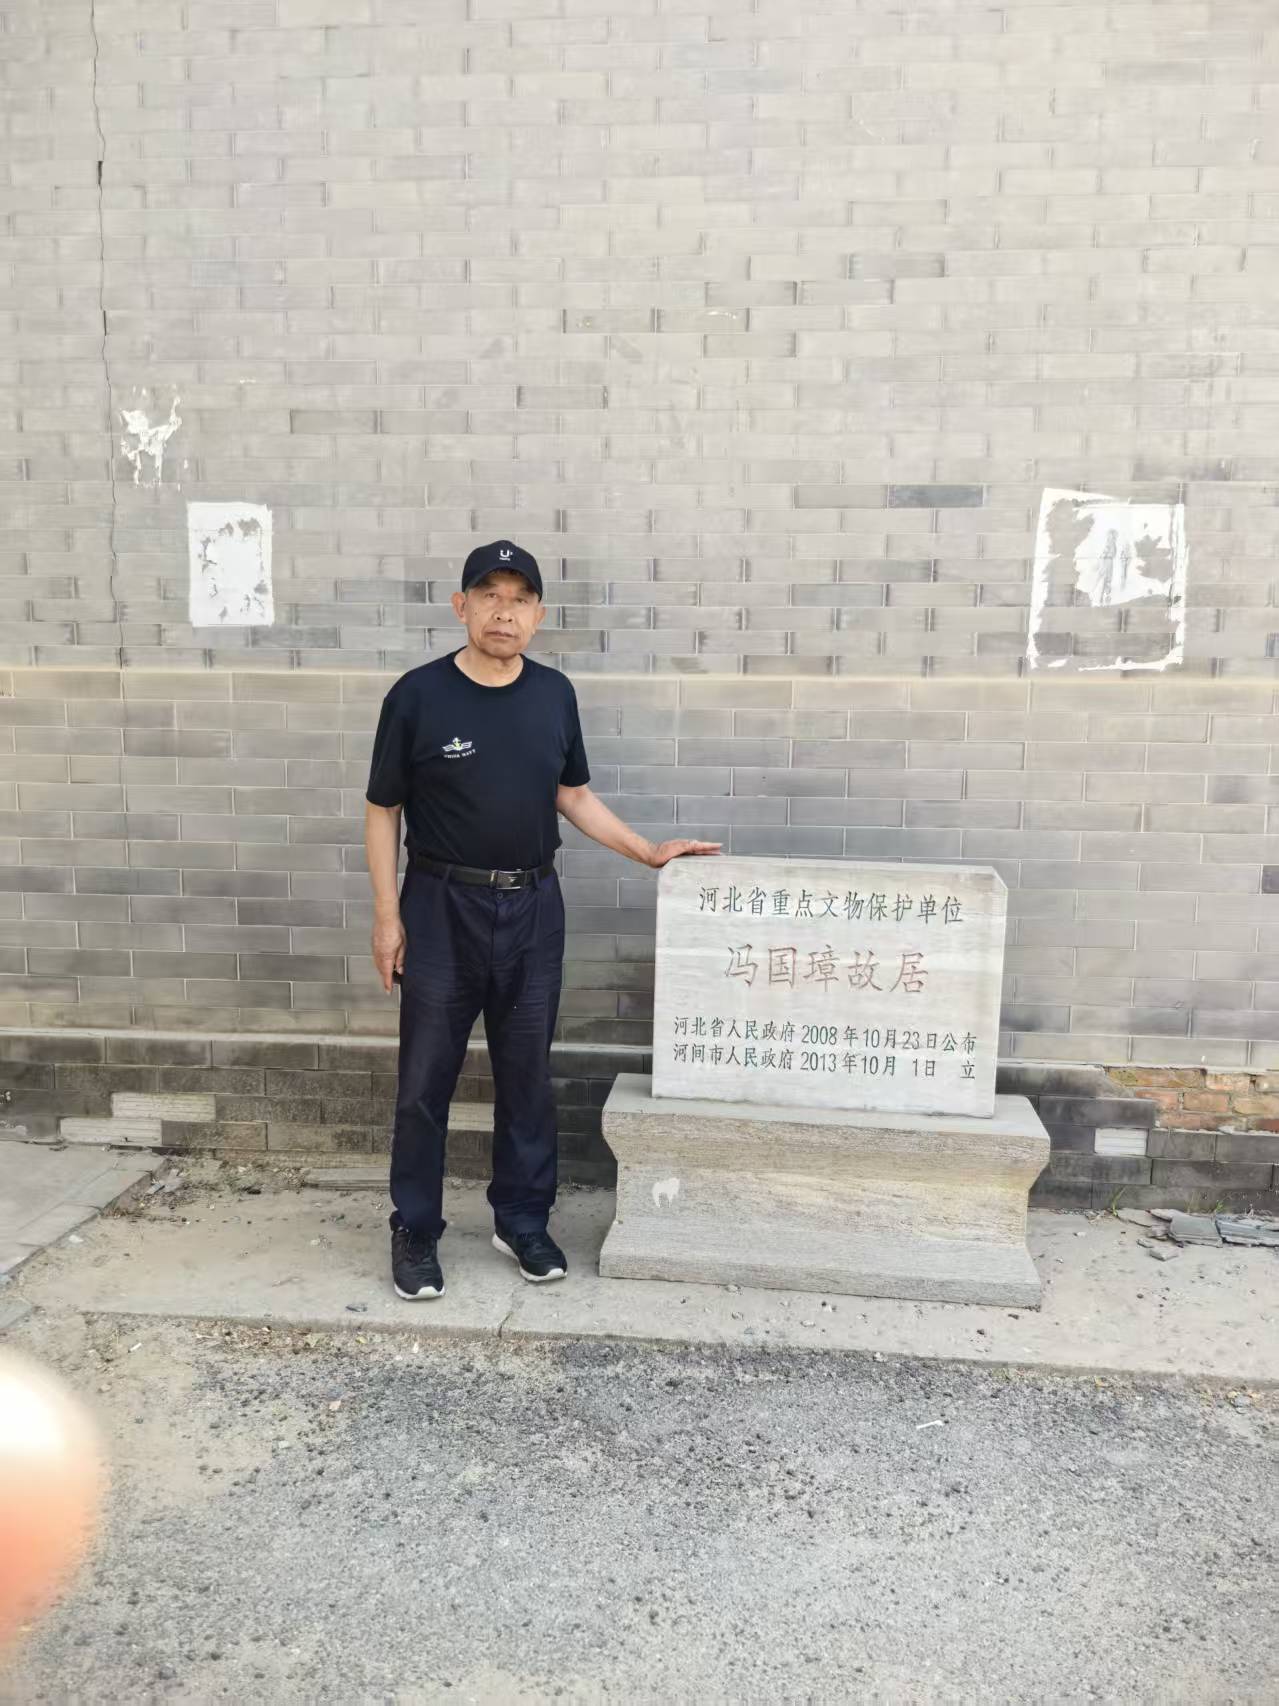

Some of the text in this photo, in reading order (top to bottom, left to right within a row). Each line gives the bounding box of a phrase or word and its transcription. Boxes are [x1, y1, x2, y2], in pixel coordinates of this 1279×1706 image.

[699, 886, 963, 924] 河北省重点文物保护单位
[724, 943, 928, 993] 冯国璋故居
